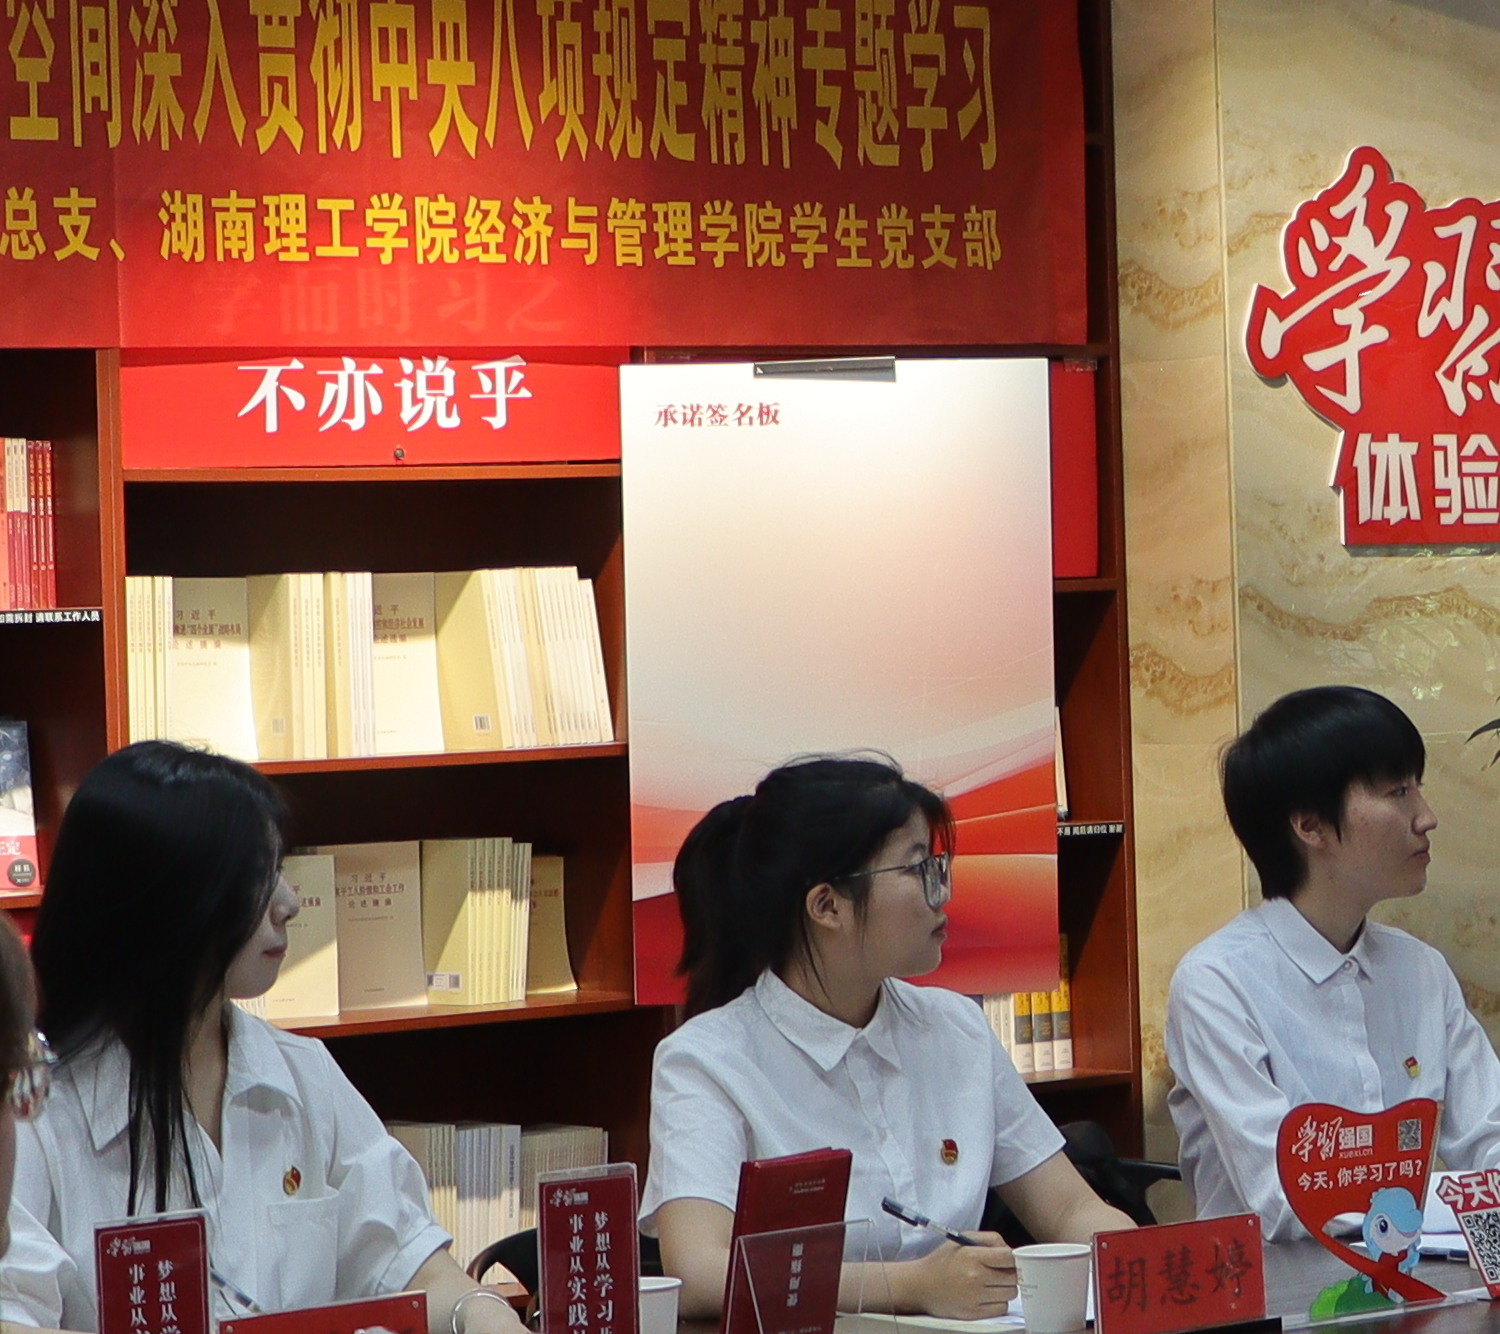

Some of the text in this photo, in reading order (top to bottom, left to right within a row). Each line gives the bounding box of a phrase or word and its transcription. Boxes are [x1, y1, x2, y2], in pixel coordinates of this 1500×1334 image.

[237, 354, 533, 434] 不亦说乎
[653, 401, 782, 429] 承诺签名板
[35, 610, 100, 623] 请联系工作人员
[176, 609, 217, 621] 习近平
